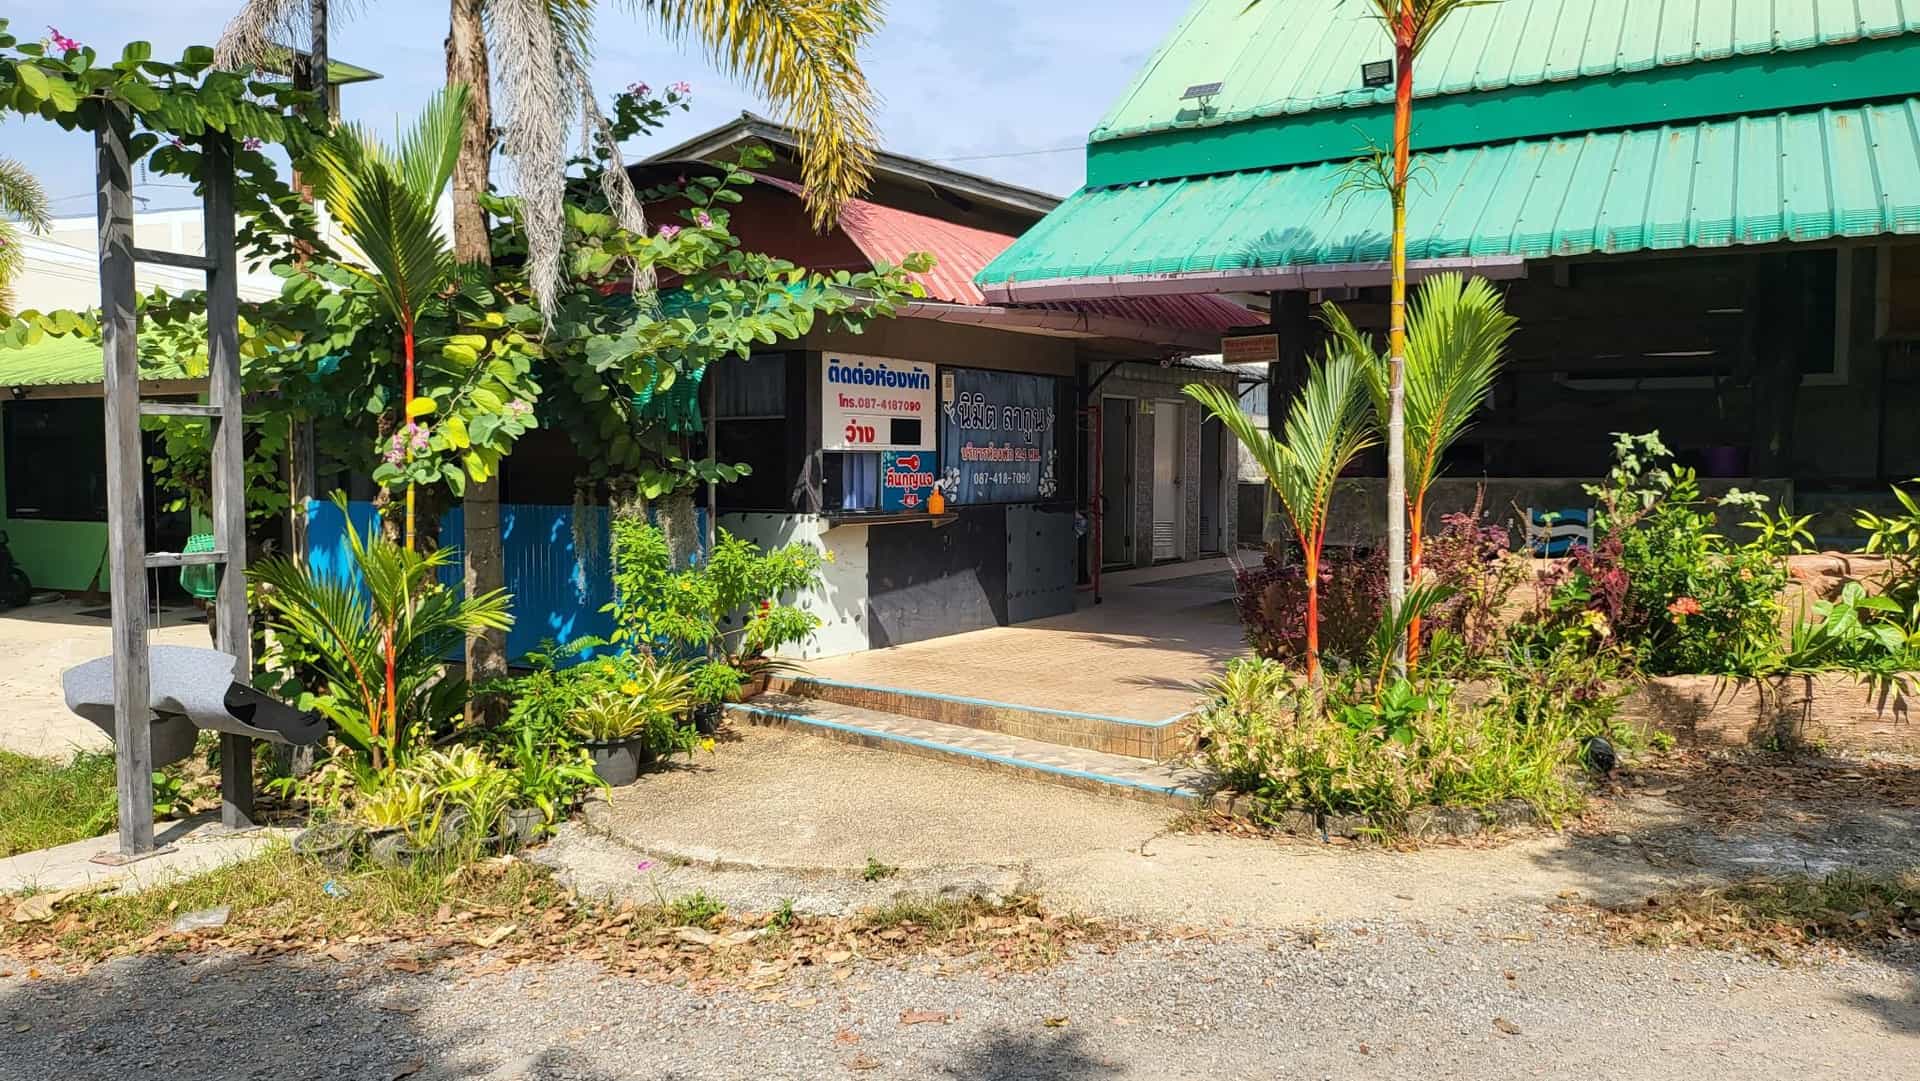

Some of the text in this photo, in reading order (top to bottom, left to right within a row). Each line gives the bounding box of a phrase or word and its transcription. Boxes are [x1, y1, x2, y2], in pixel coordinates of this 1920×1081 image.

[828, 359, 930, 390] ติดต่อห้องพัก
[845, 419, 875, 443] ว่าง
[958, 392, 1045, 444] นิมิต ลากูน
[885, 467, 934, 493] คืนกุญแจ
[973, 472, 1031, 485] 087-418-7090
